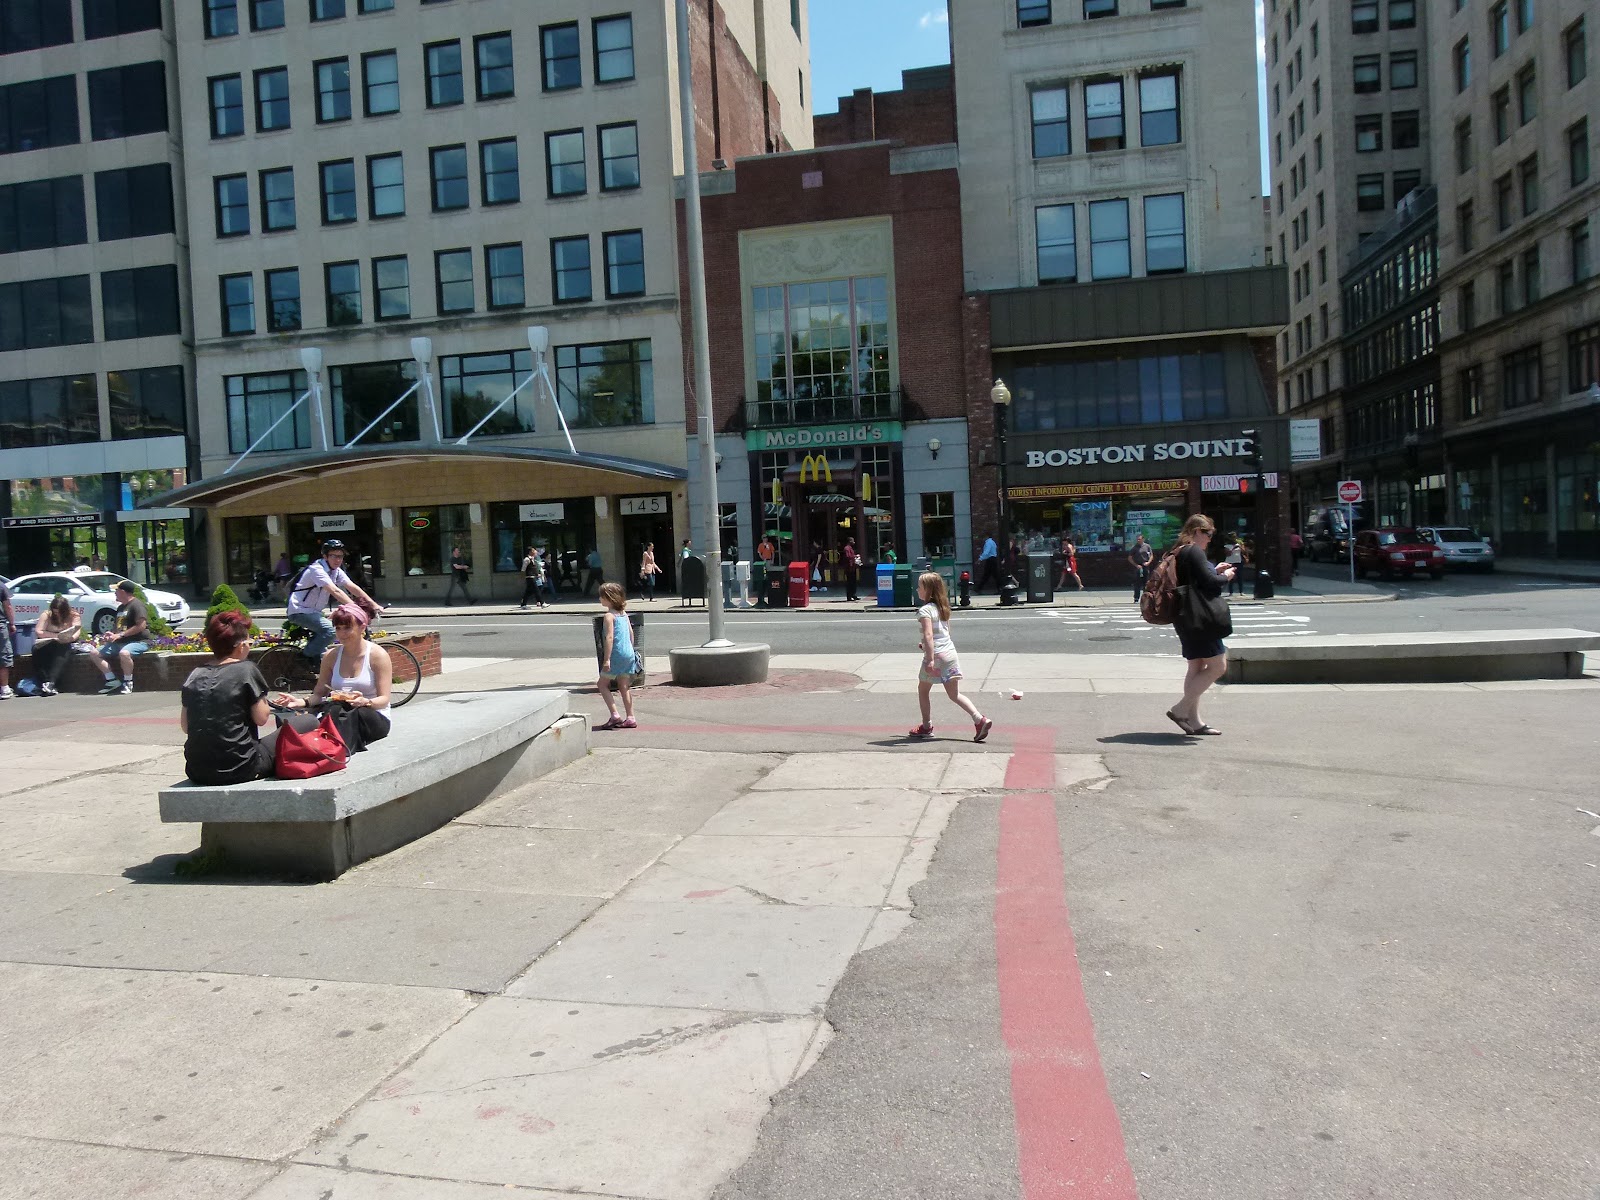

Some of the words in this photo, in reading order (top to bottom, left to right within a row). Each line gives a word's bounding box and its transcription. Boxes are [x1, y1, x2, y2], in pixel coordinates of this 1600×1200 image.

[765, 425, 882, 447] McDonald's
[1026, 444, 1147, 468] BOSTON
[1153, 438, 1255, 461] SOUND
[1007, 488, 1034, 497] OURIST
[1035, 486, 1084, 496] INFORMATION
[1086, 484, 1113, 493] CENTER
[1123, 482, 1156, 492] TROLLEY
[1157, 481, 1181, 490] TOURS
[1074, 501, 1109, 511] SONY
[1128, 511, 1151, 519] metro
[320, 519, 348, 528] SUBWAY
[412, 519, 427, 527] OPEN
[14, 605, 40, 613] 536-5100
